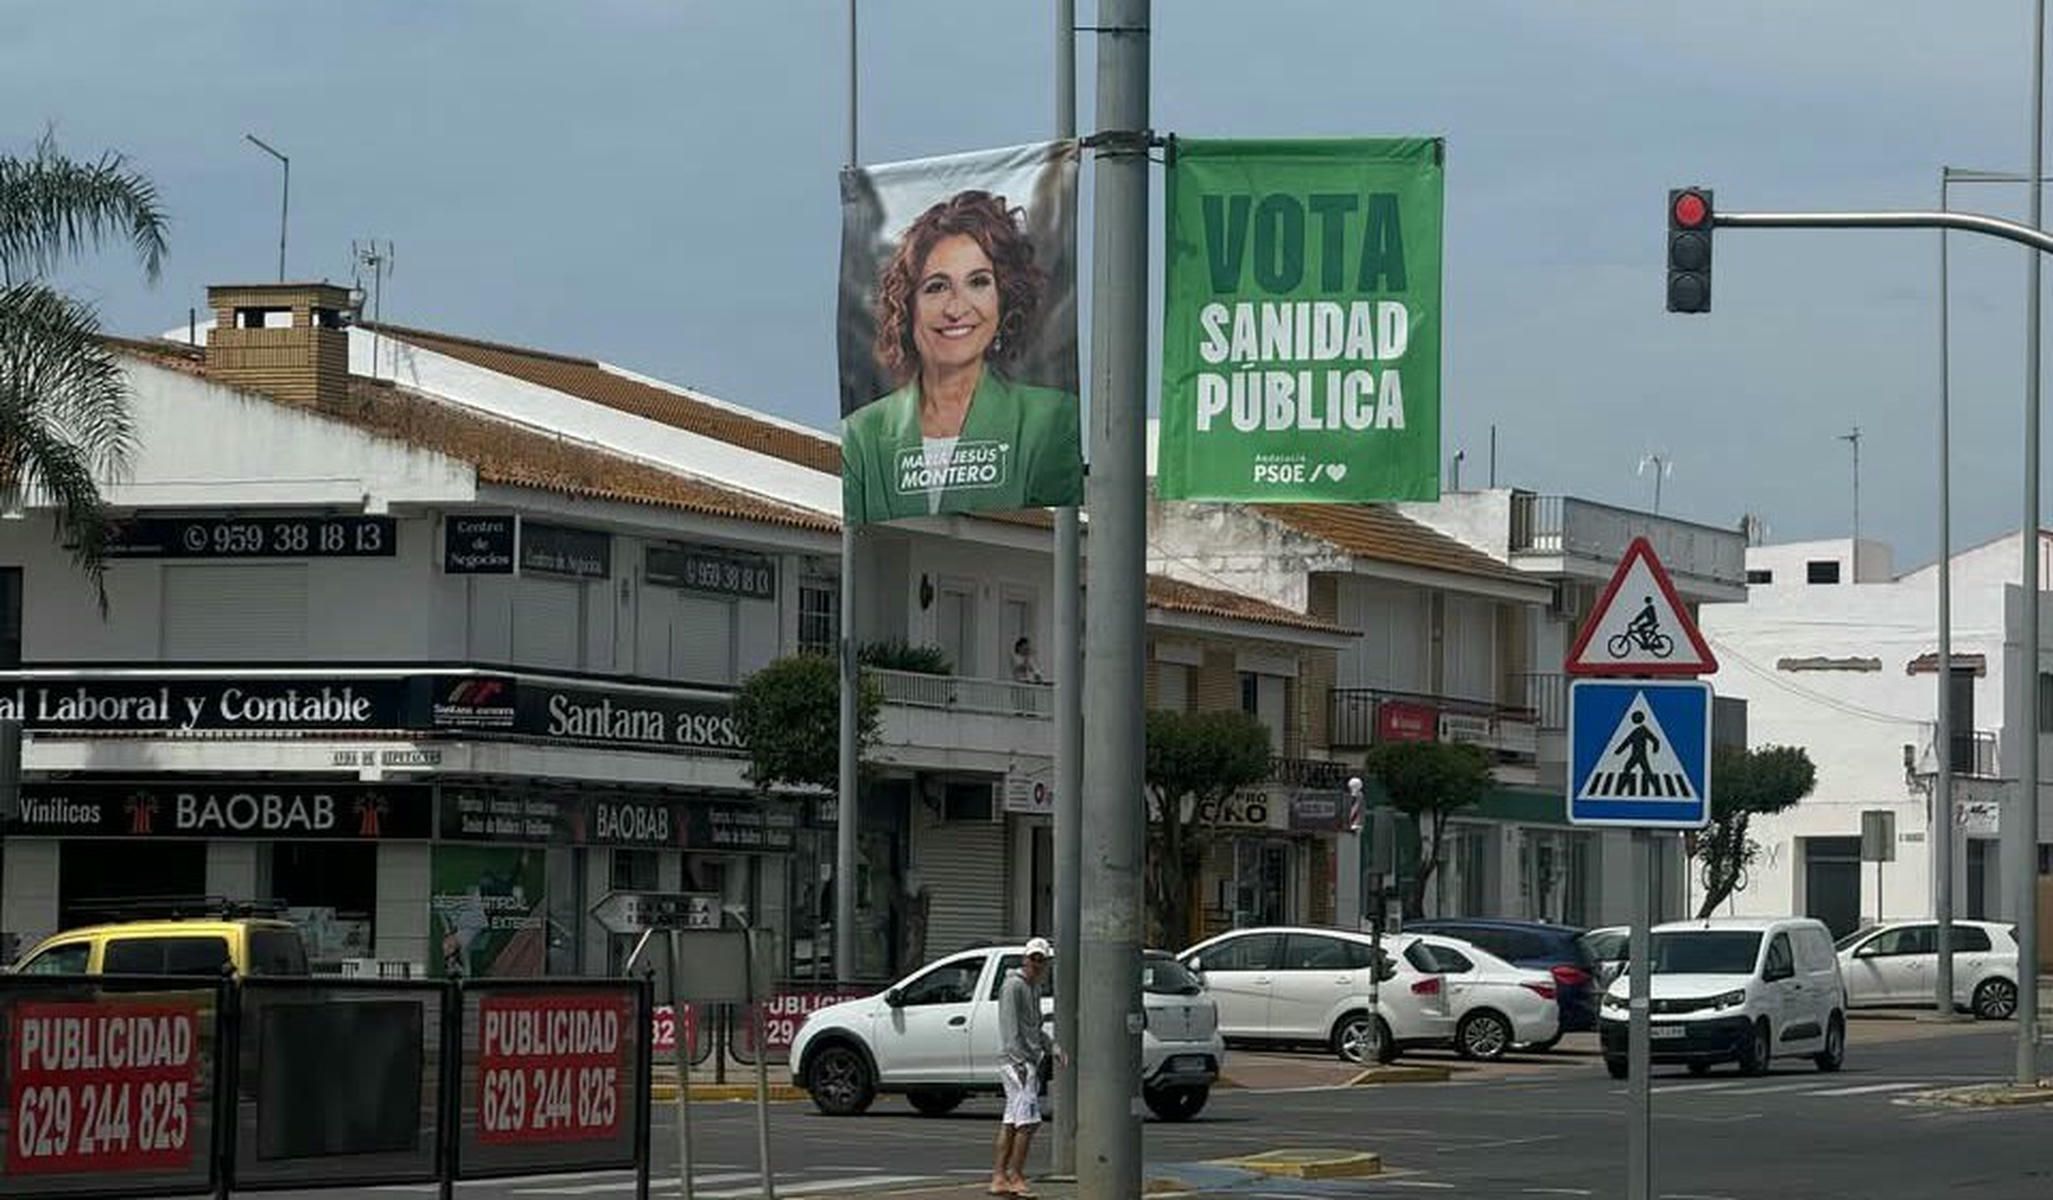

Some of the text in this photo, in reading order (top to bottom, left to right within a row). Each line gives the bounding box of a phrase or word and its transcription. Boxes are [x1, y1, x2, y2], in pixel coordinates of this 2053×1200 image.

[1203, 193, 1408, 294] VOTA
[1200, 301, 1408, 363] SANIDAD
[1197, 363, 1405, 433] PÚBLICA
[951, 445, 997, 464] JESÚS
[1253, 464, 1306, 483] PSOE
[901, 464, 997, 489] MONTERO
[213, 523, 381, 552] 959 38 18 13
[472, 536, 490, 550] de
[451, 552, 510, 568] Negocios
[37, 688, 169, 722] Laboral
[183, 697, 206, 729] y
[220, 688, 371, 722] Contable
[548, 693, 664, 742] Santana
[20, 797, 101, 824] Vinílicos
[176, 794, 335, 830] BAOBAB
[596, 803, 668, 841] BAOBAB
[21, 1015, 191, 1071] PUBLICIDAD
[484, 1010, 618, 1057] PUBLICIDAD
[483, 1066, 616, 1132] 629 244 825
[19, 1080, 189, 1158] 629 244 825
